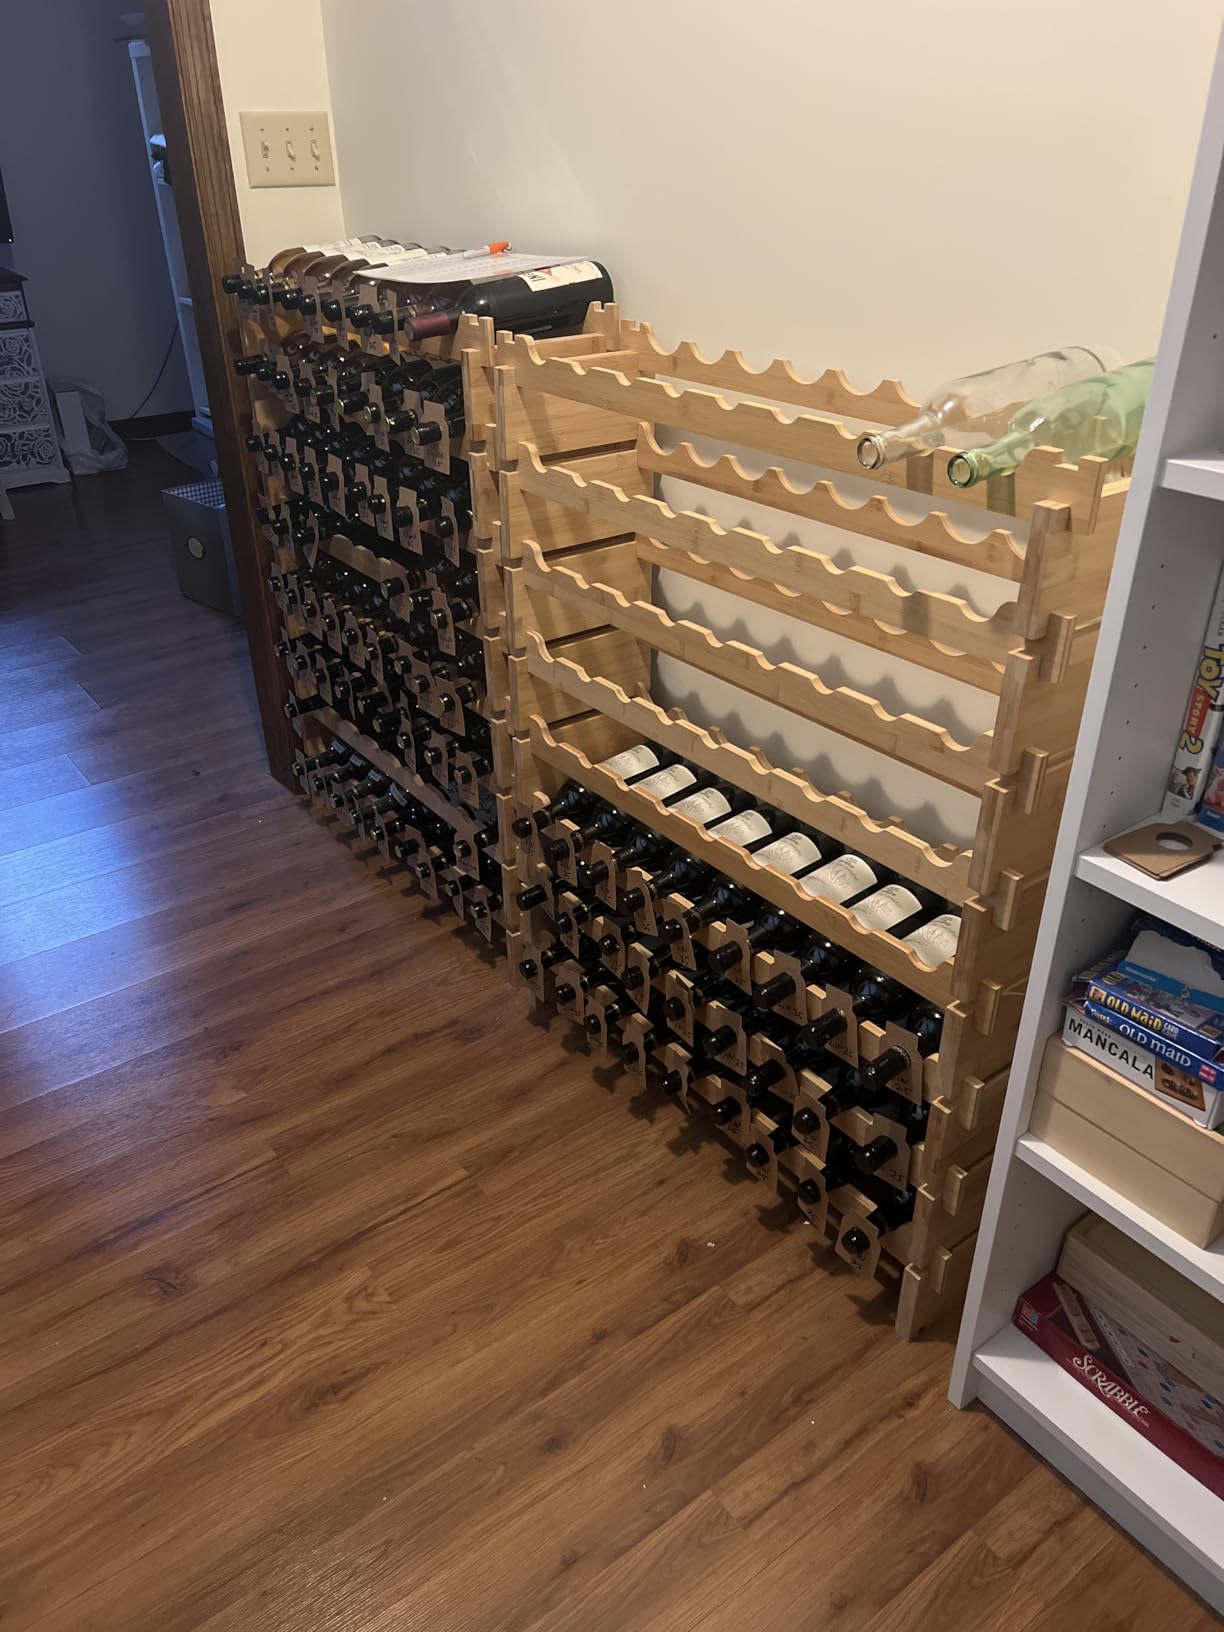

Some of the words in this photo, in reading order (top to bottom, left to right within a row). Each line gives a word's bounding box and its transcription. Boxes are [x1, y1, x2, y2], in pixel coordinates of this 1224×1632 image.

[1196, 644, 1224, 703] TOY
[1188, 693, 1205, 735] STORY
[1179, 730, 1204, 754] 2
[1107, 996, 1129, 1013] OLD
[1068, 1018, 1154, 1080] MANCALA
[1119, 1024, 1147, 1044] OLD
[1072, 1355, 1149, 1416] SCRABBLE
